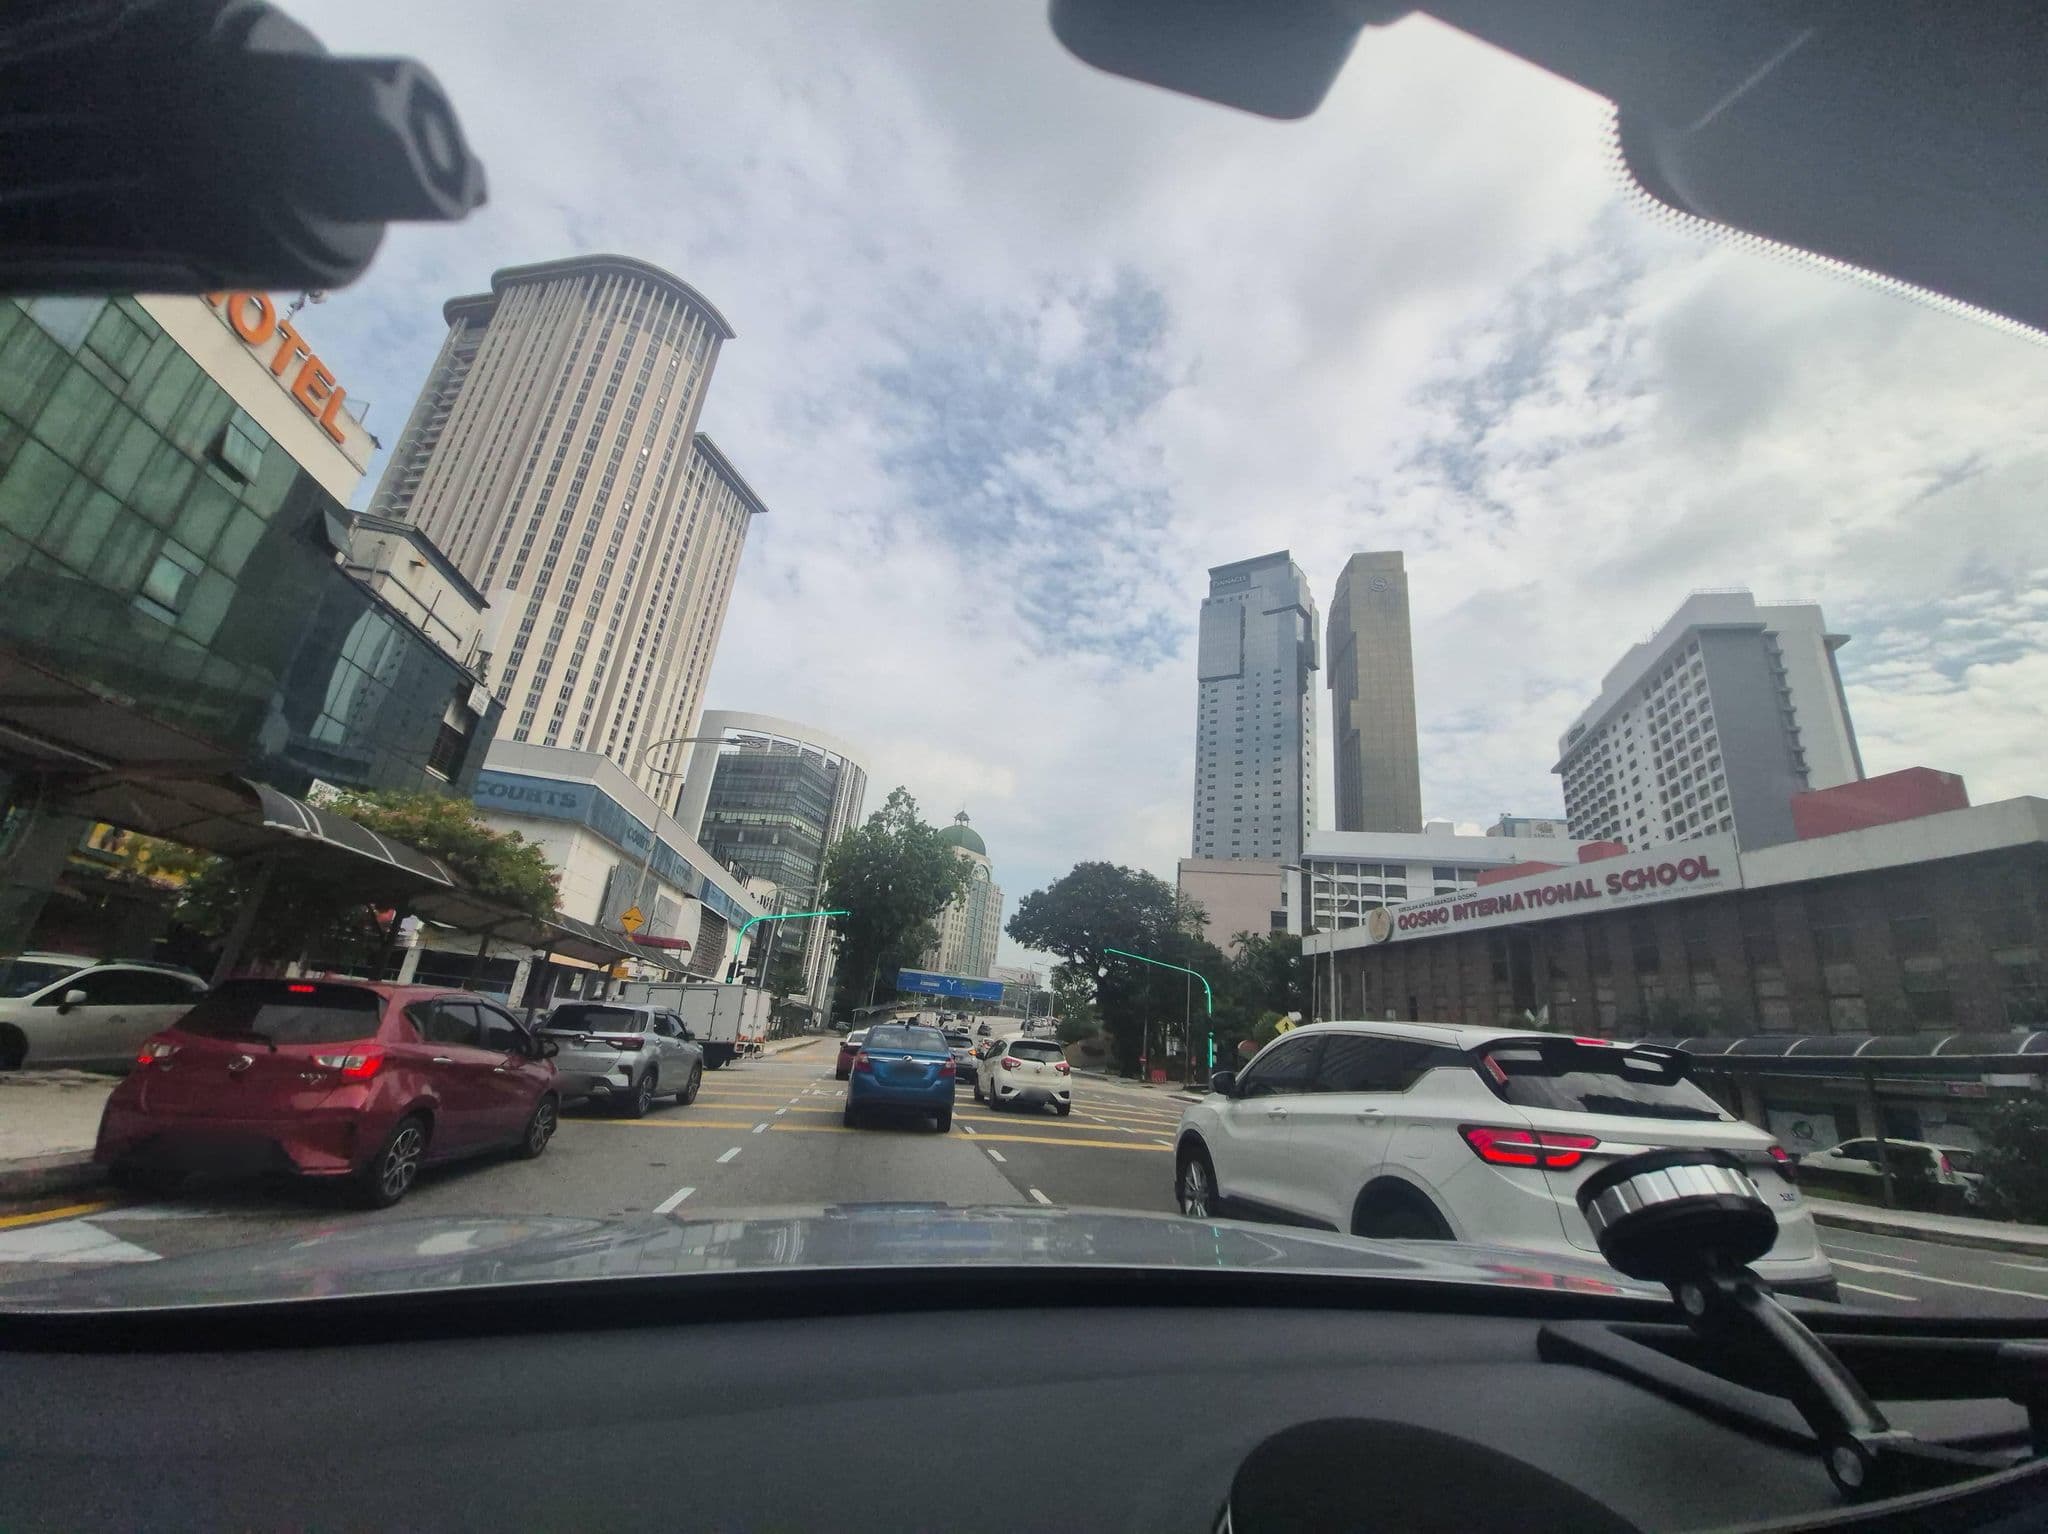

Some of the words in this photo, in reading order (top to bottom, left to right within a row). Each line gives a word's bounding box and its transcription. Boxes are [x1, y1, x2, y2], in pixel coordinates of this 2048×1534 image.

[207, 290, 346, 444] OTEL
[1398, 907, 1449, 930] QOSMO
[1453, 879, 1602, 922] INTERNATIONAL
[1606, 855, 1720, 896] SCHOOL
